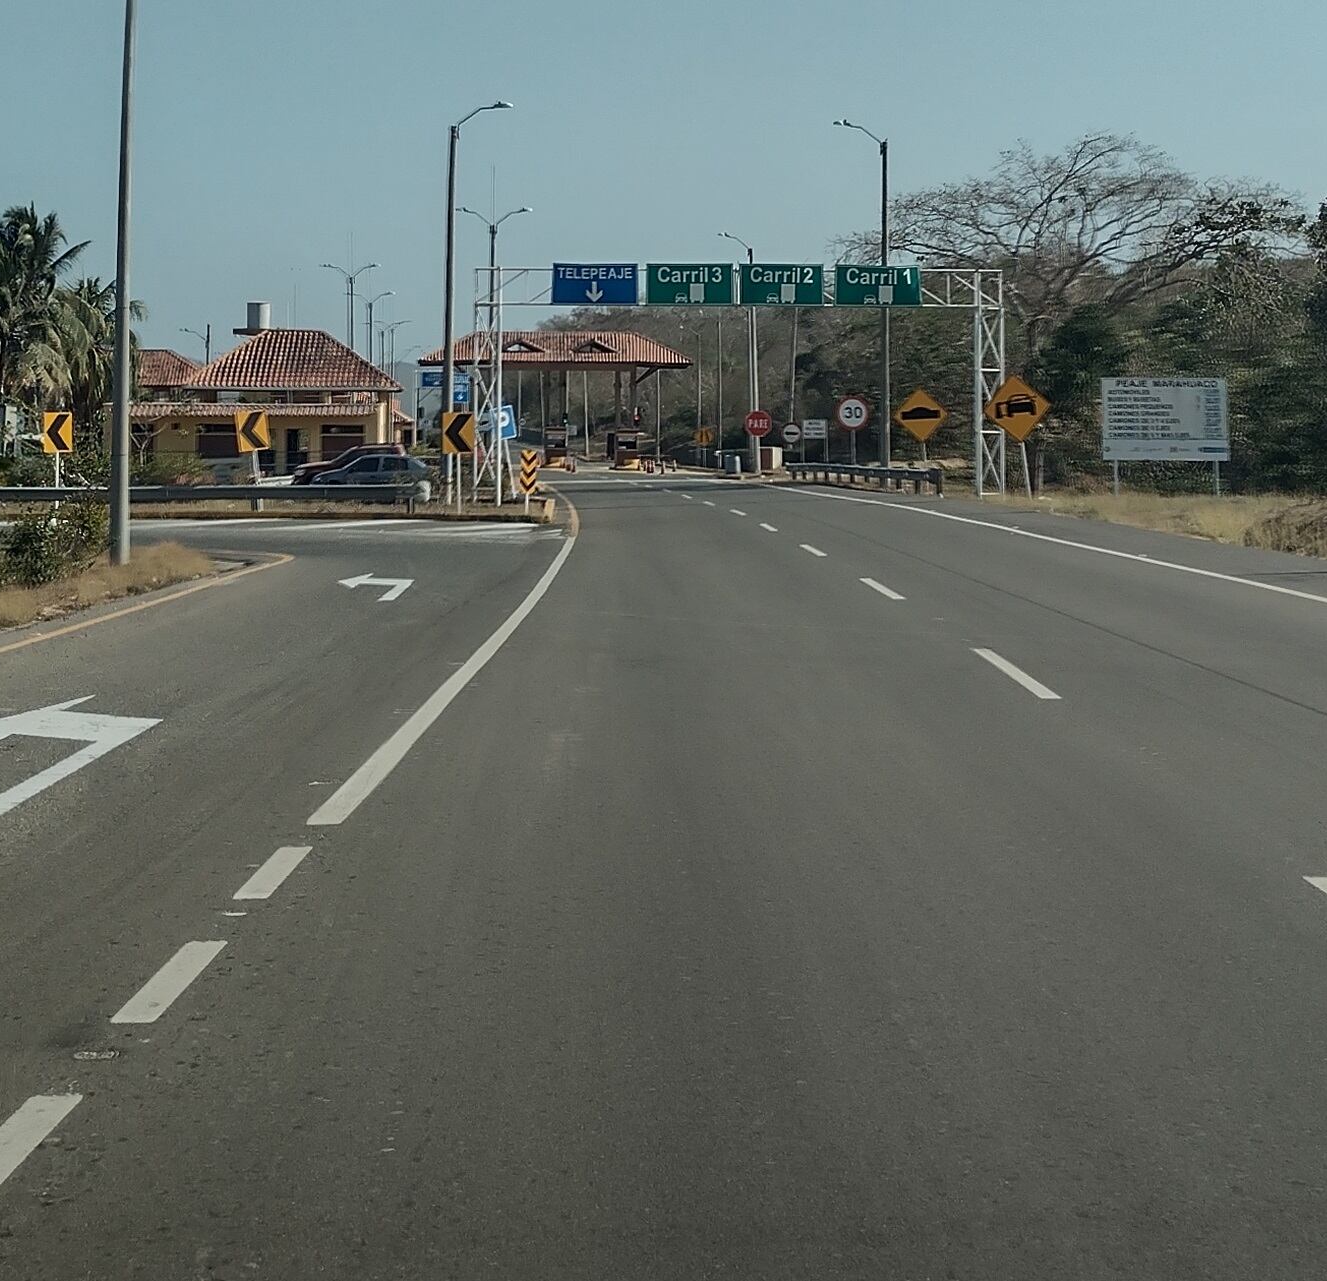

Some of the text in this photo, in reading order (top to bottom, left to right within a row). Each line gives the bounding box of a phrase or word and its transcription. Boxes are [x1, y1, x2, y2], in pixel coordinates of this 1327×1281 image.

[558, 267, 632, 281] TELEPEAJE
[657, 267, 723, 284] Carril 3
[750, 267, 814, 284] Carril 2
[846, 268, 912, 286] Carril 1
[844, 406, 863, 419] 30
[748, 418, 768, 429] PARE
